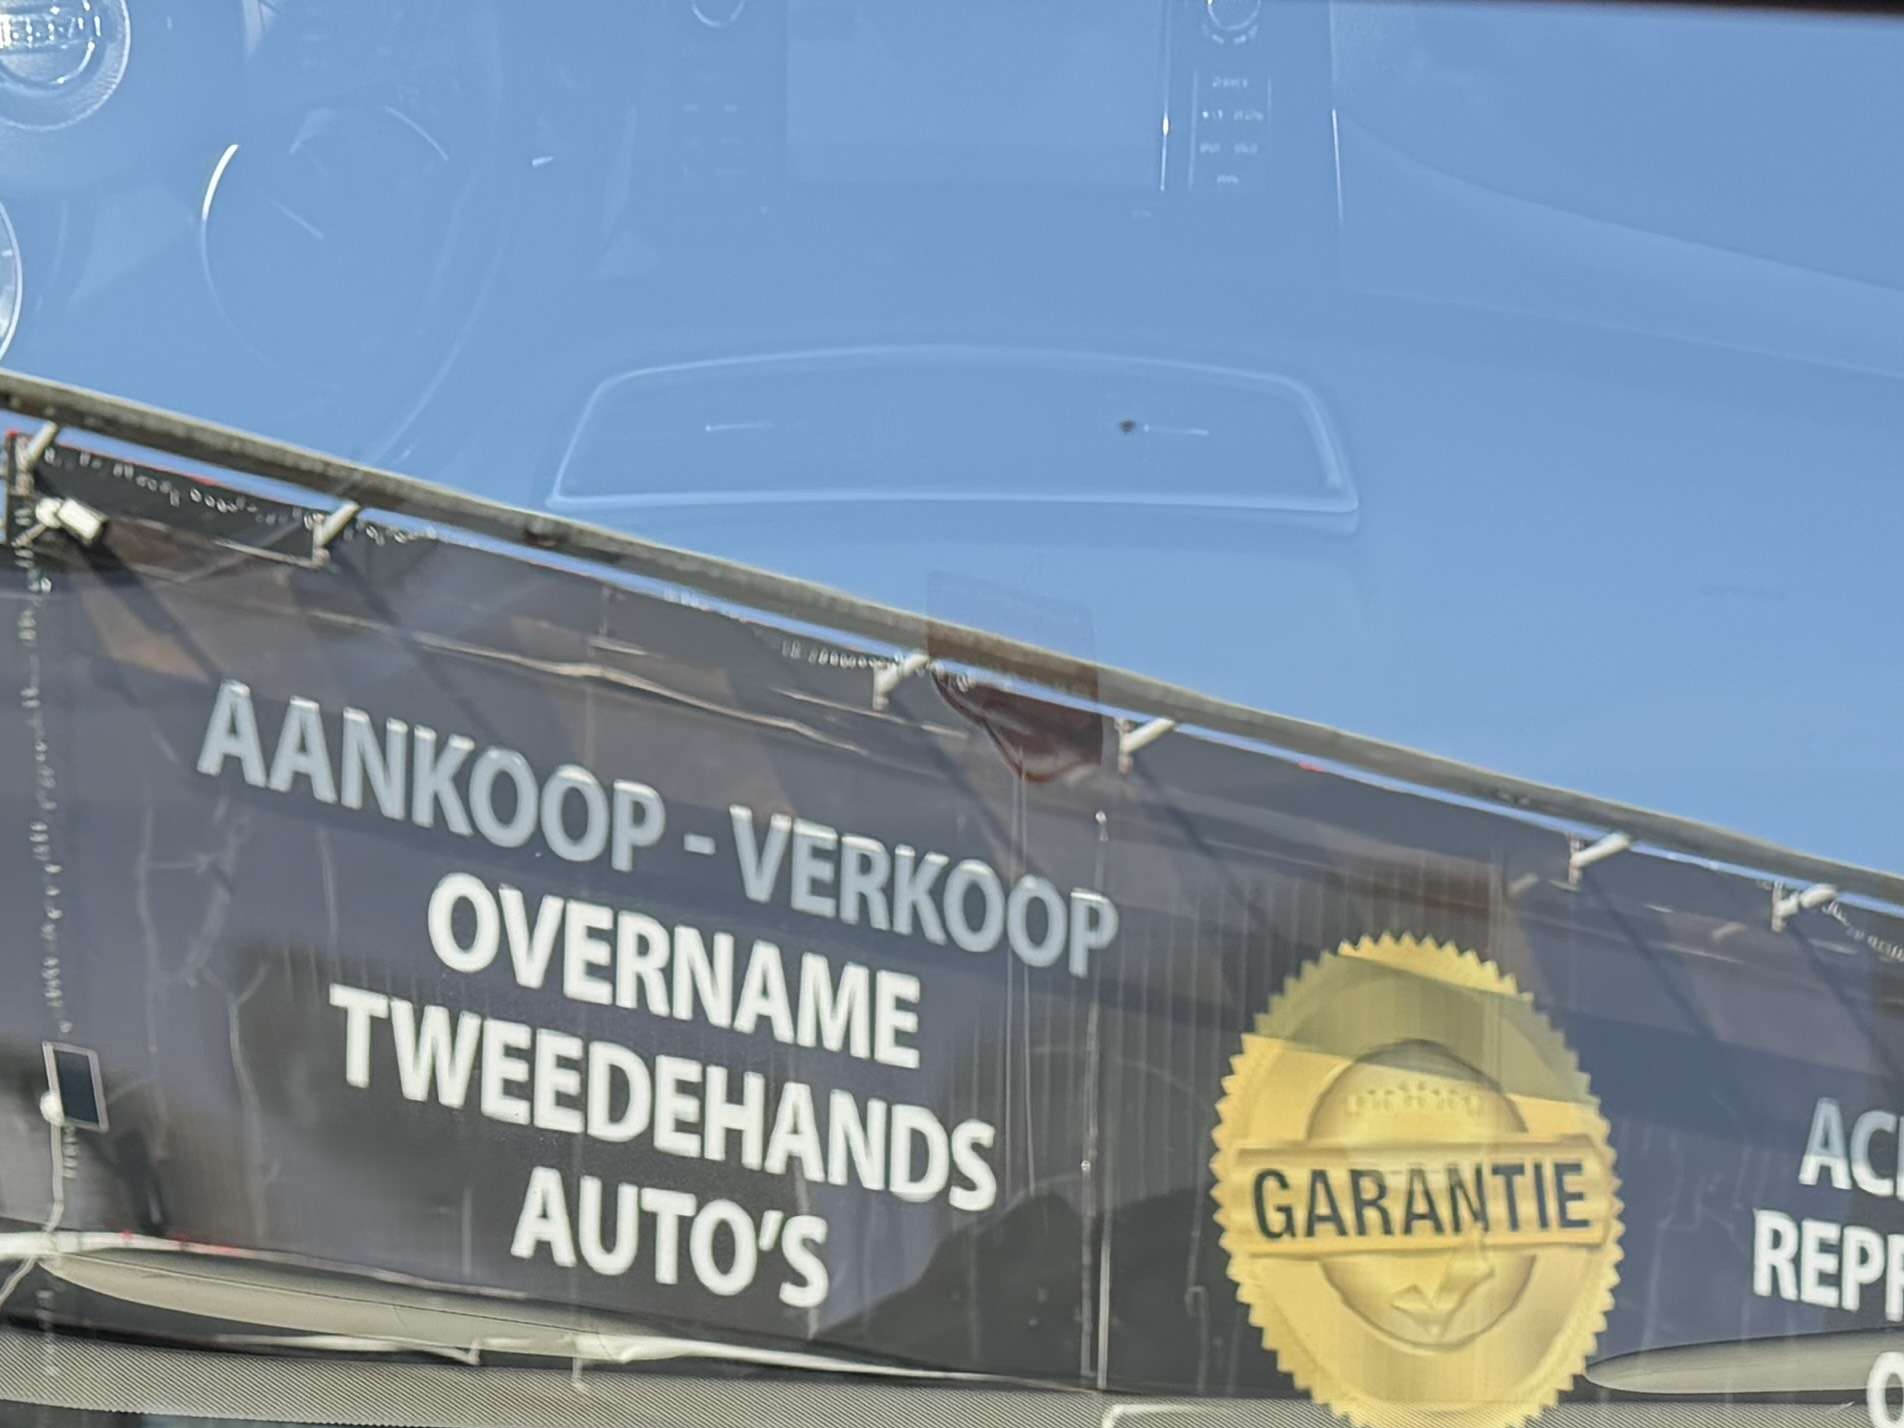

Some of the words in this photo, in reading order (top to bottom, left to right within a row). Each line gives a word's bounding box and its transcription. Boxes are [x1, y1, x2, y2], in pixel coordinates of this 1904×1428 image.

[197, 680, 665, 871] AANKOOP
[730, 804, 1118, 978] VERKOOP
[428, 873, 921, 1068] OVERNAME
[330, 985, 996, 1212] TWEEDEHANDS
[510, 1165, 829, 1309] AUTO'S
[1252, 1159, 1591, 1241] GARANTIE
